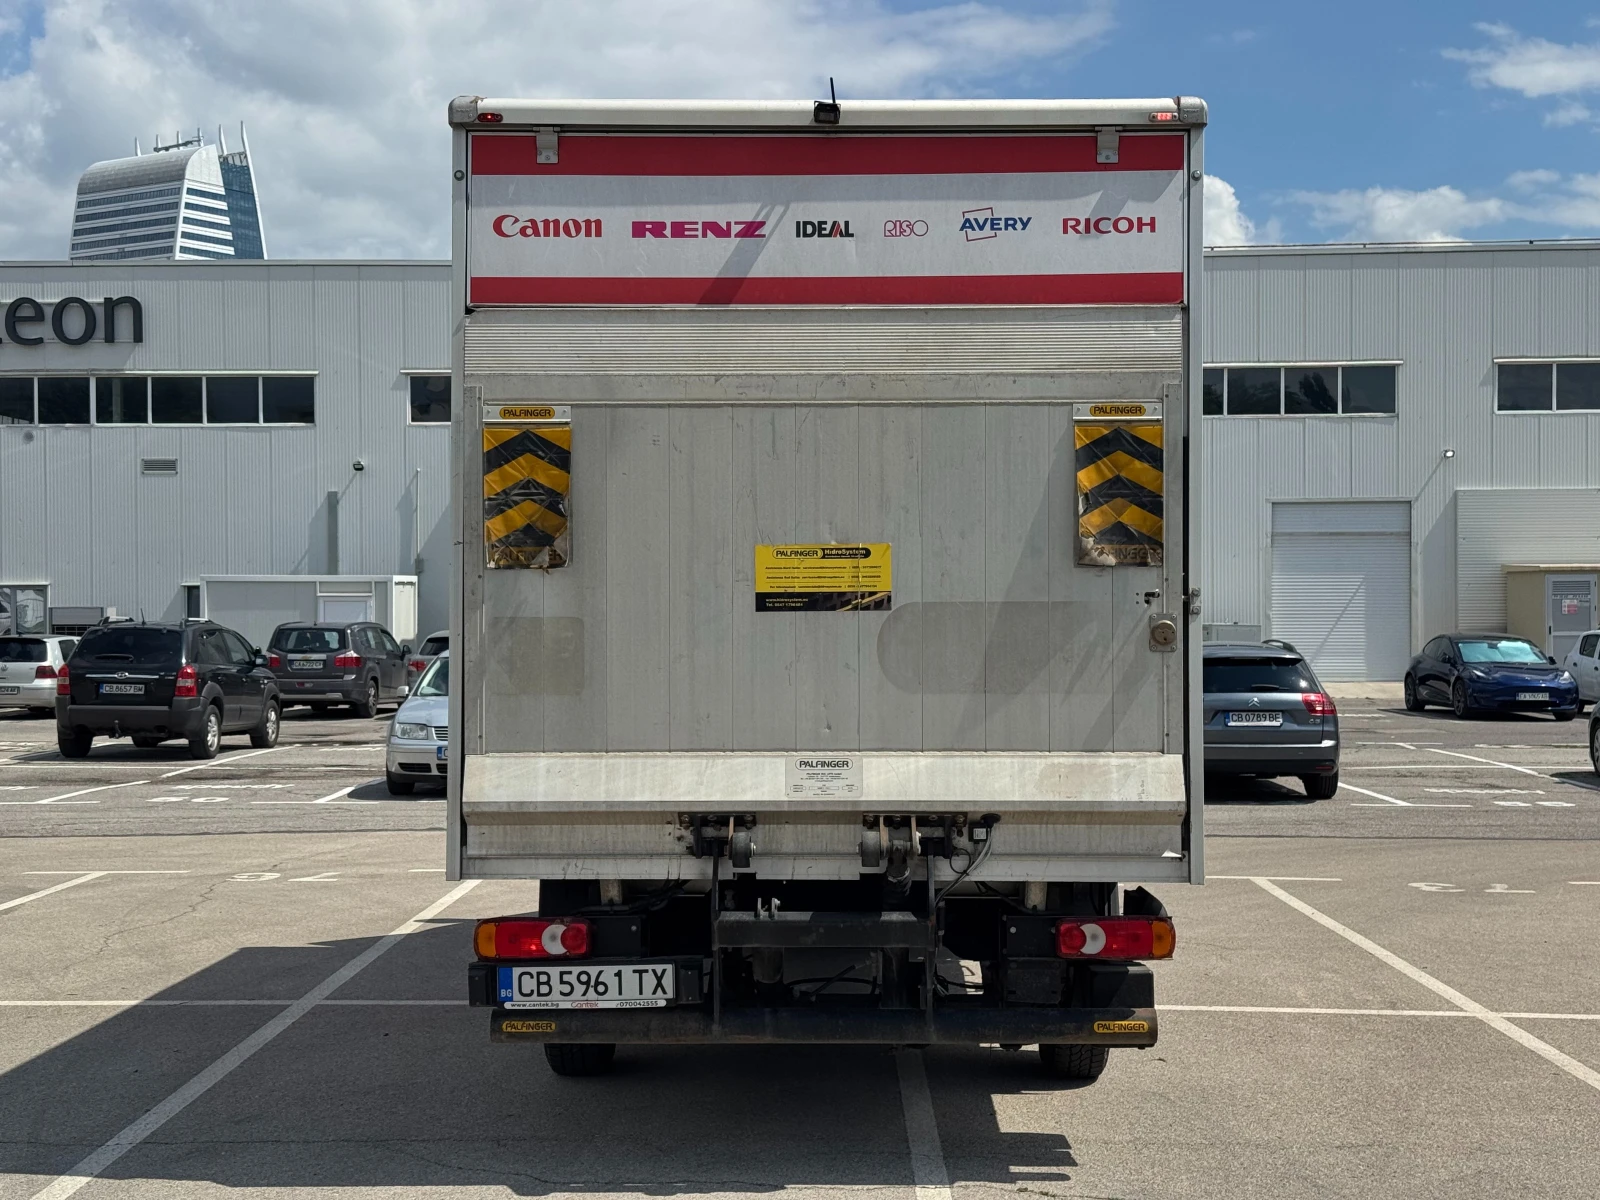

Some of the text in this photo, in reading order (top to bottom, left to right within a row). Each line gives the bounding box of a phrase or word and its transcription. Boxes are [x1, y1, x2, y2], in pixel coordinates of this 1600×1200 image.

[492, 214, 602, 238] Canon
[631, 221, 767, 238] RENZ
[795, 220, 855, 238] IDEAL
[883, 219, 929, 237] RISO
[959, 217, 1033, 232] AVERY
[1062, 216, 1157, 235] RICOH
[0, 296, 143, 345] eon
[503, 409, 551, 417] PALFINGER
[1093, 406, 1142, 414] PALFINGER
[775, 550, 819, 558] PALFINGER
[1231, 713, 1281, 722] CB 0789 BE
[799, 760, 849, 768] PALFINGER
[517, 968, 668, 998] CB 5961 TX
[500, 989, 512, 997] BG
[505, 1022, 553, 1031] PALFINGER
[1097, 1022, 1145, 1031] PALFINGER
